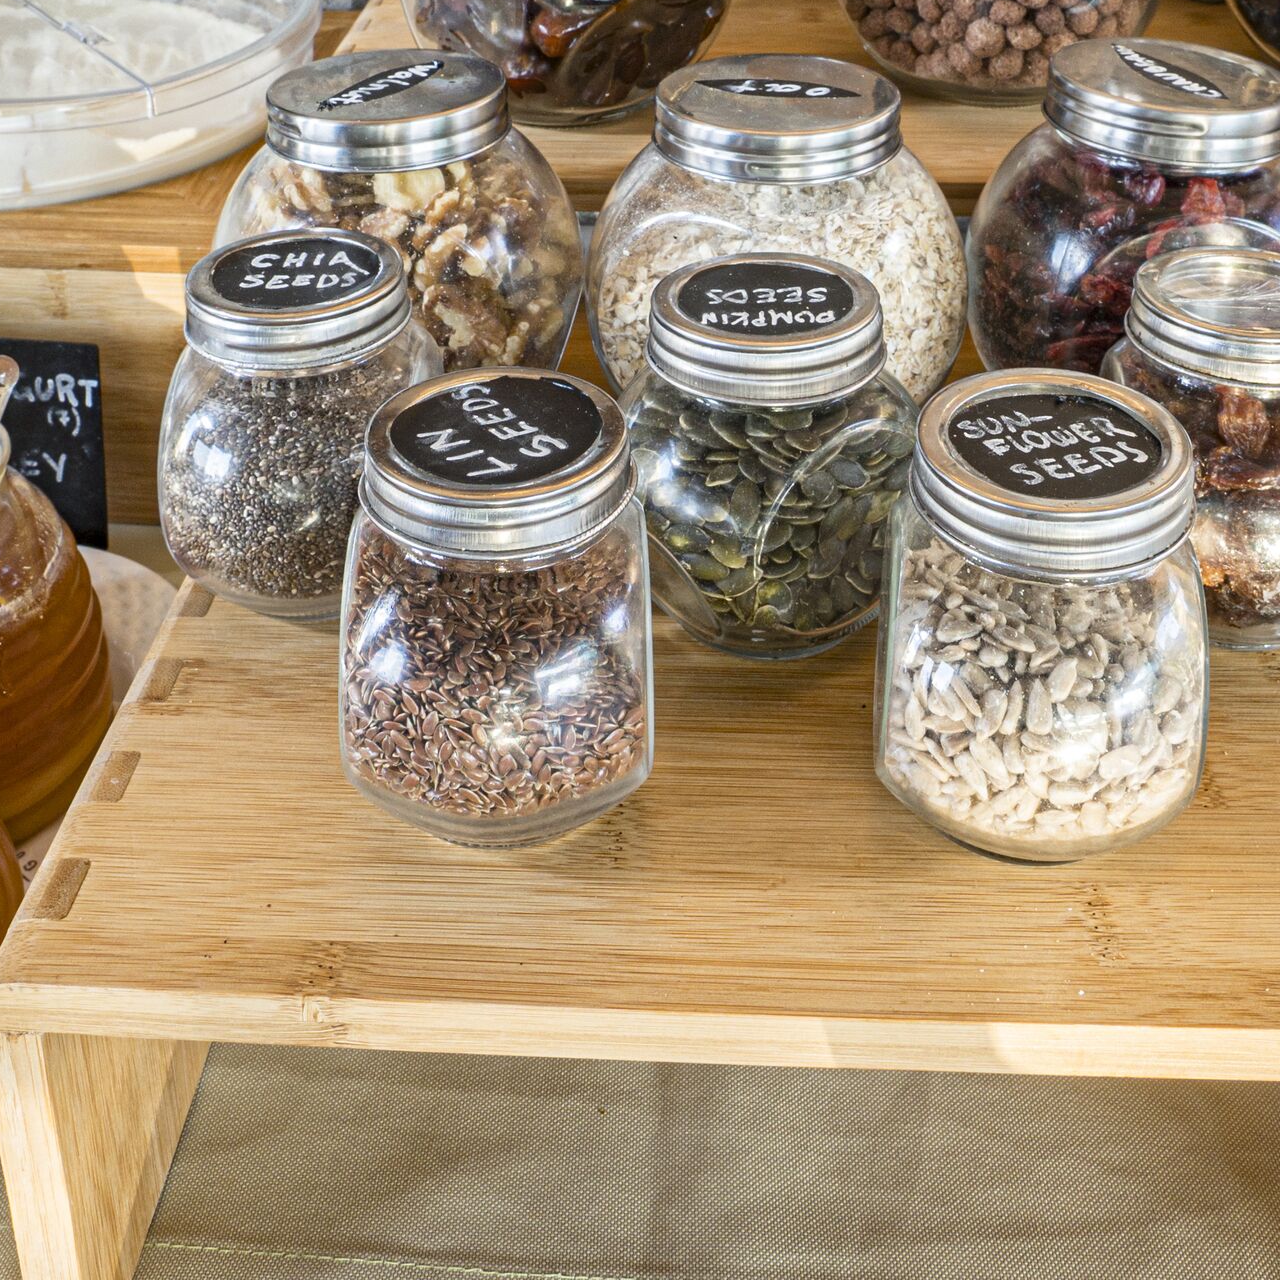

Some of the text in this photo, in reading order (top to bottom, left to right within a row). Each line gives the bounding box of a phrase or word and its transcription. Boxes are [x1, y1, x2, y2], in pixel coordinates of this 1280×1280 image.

[250, 250, 371, 276] CHIA
[238, 271, 358, 290] SEEDS
[704, 285, 829, 305] SEEDS
[700, 309, 837, 327] PUMPKIN
[451, 382, 569, 458] SEEDS
[981, 416, 1139, 457] FLOWER
[416, 428, 519, 477] LIN
[1009, 440, 1149, 486] SEEDS
